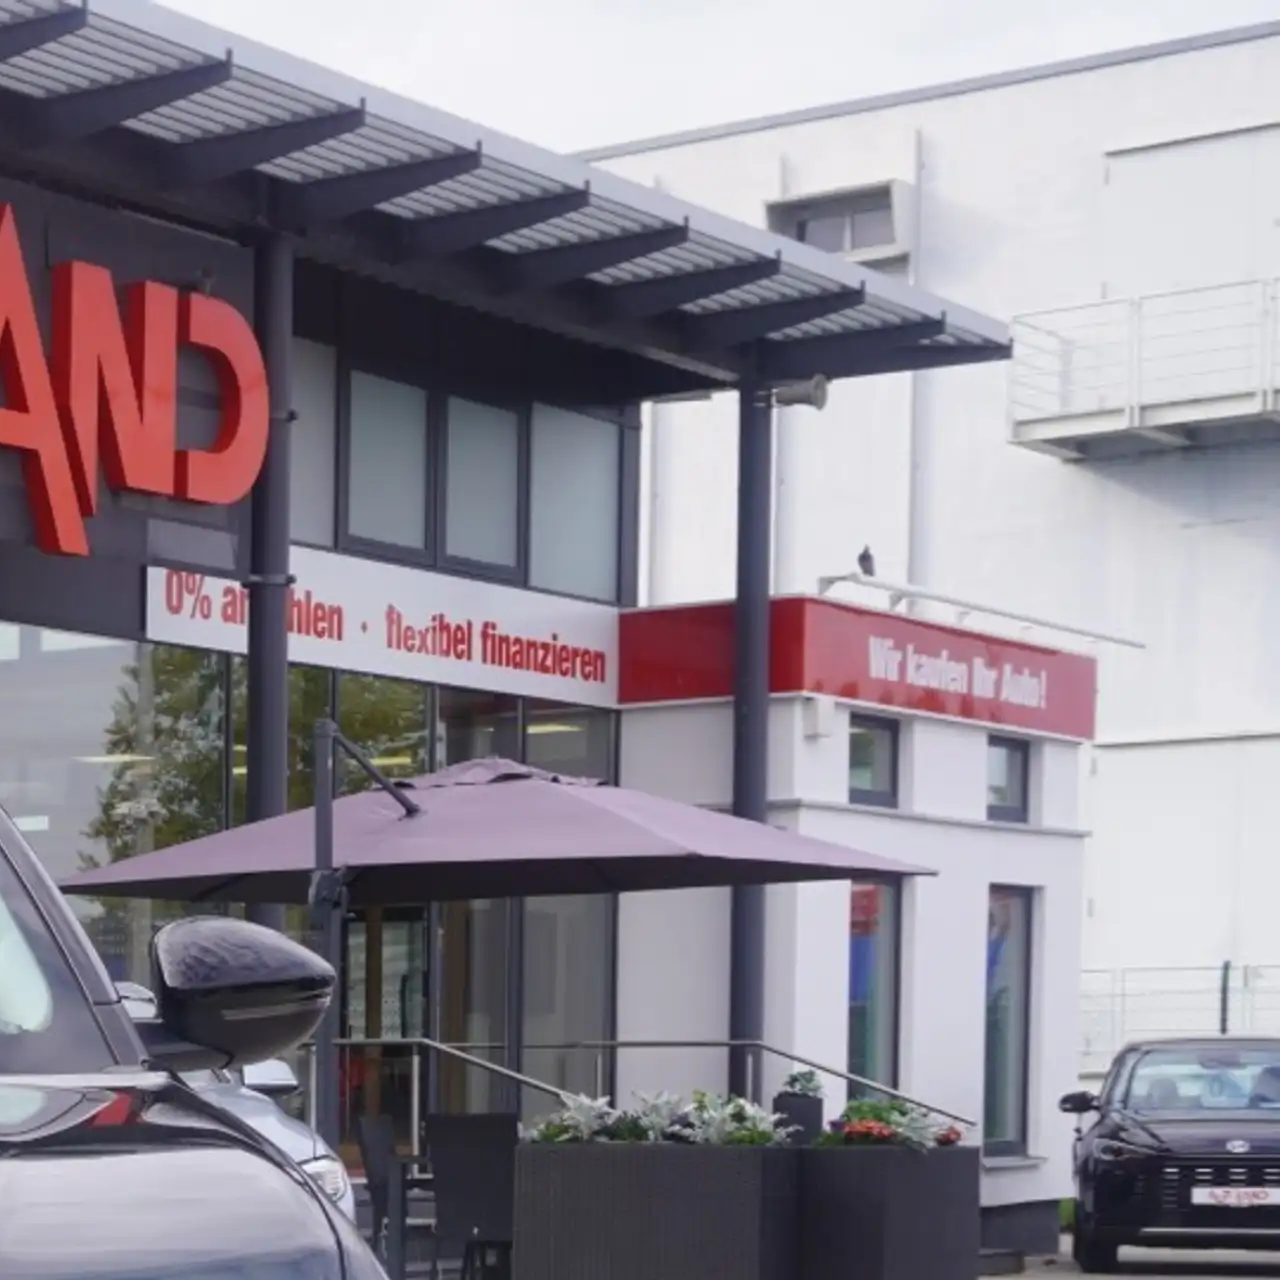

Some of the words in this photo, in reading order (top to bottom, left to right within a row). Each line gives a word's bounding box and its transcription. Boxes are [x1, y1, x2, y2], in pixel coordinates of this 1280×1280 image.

[165, 568, 212, 620] 0%
[385, 603, 473, 662] flexibel
[481, 620, 606, 683] finanzieren
